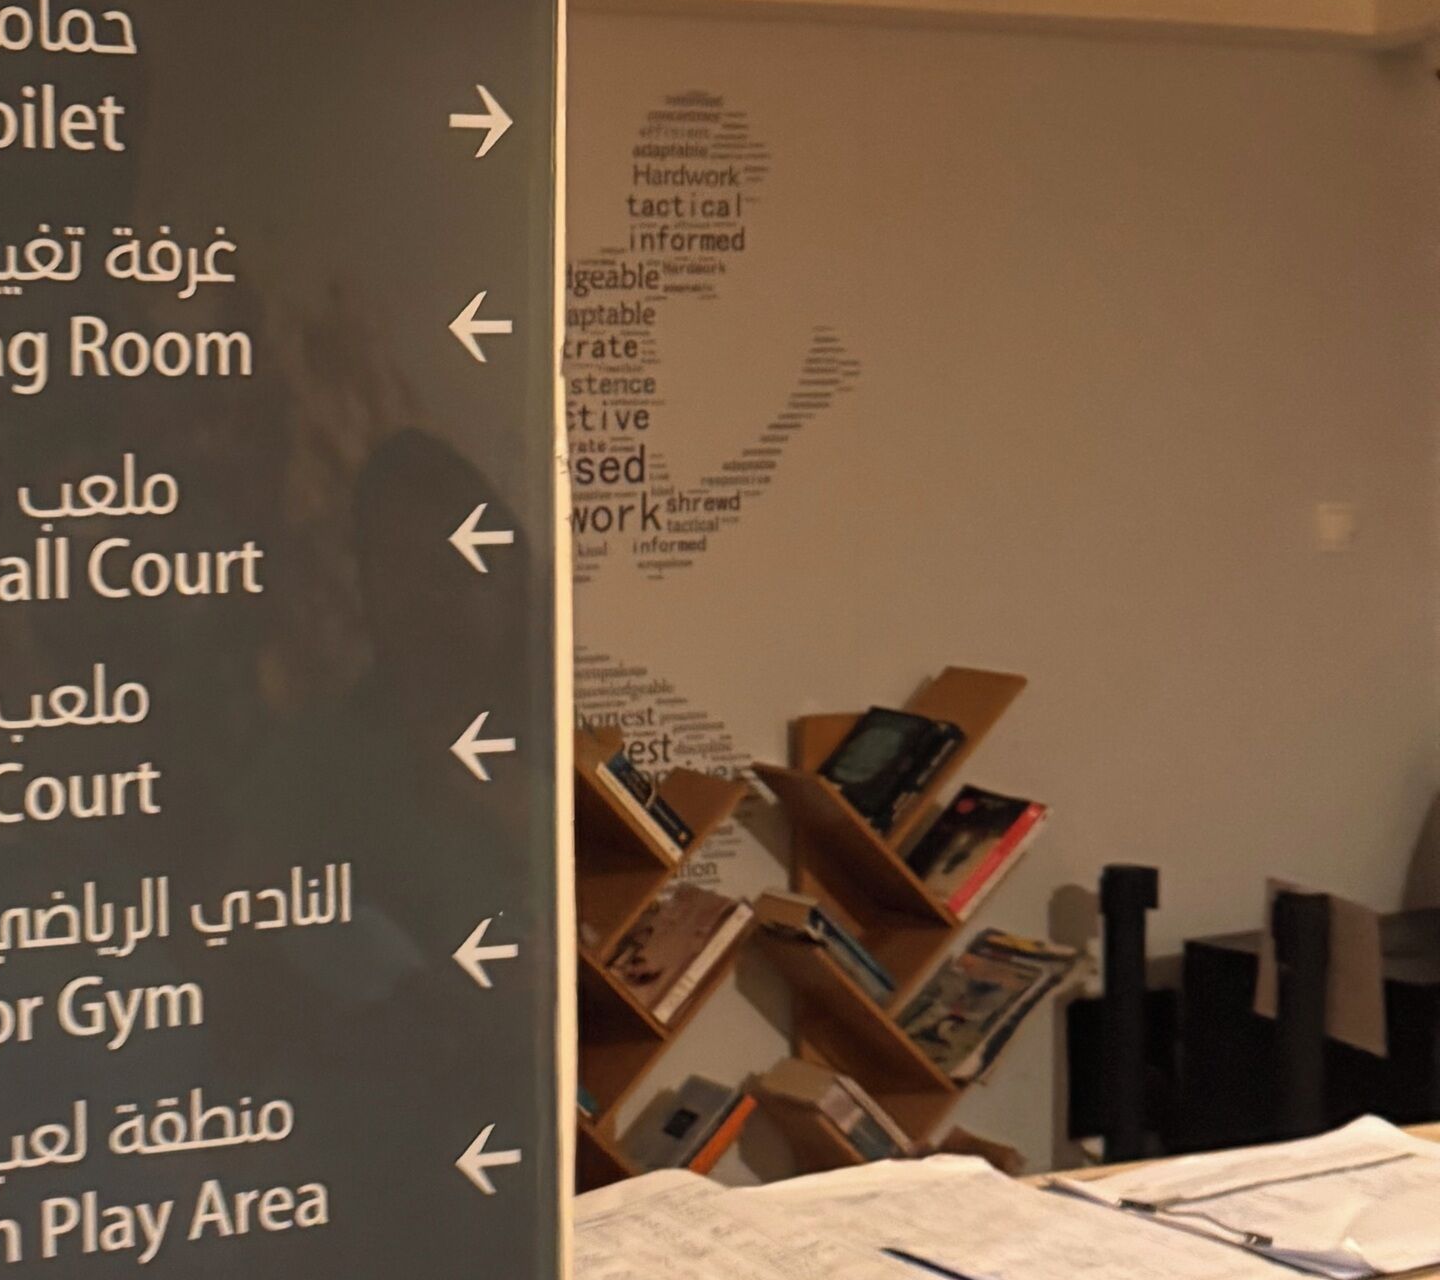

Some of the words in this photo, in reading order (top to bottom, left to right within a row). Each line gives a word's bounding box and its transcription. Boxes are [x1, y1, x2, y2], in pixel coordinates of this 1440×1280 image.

[626, 192, 742, 218] tactical
[632, 163, 740, 187] Hardwork
[105, 225, 238, 299] غرفة
[629, 224, 746, 253] informed
[70, 315, 253, 378] Room
[17, 452, 180, 533] ملعب
[666, 491, 742, 513] shrewd
[88, 537, 265, 601] Court
[633, 535, 707, 554] informed
[190, 862, 353, 947] النادي
[57, 975, 204, 1052] Gym
[108, 1087, 295, 1157] منطقة
[41, 1190, 174, 1265] Play
[187, 1179, 330, 1242] Area
